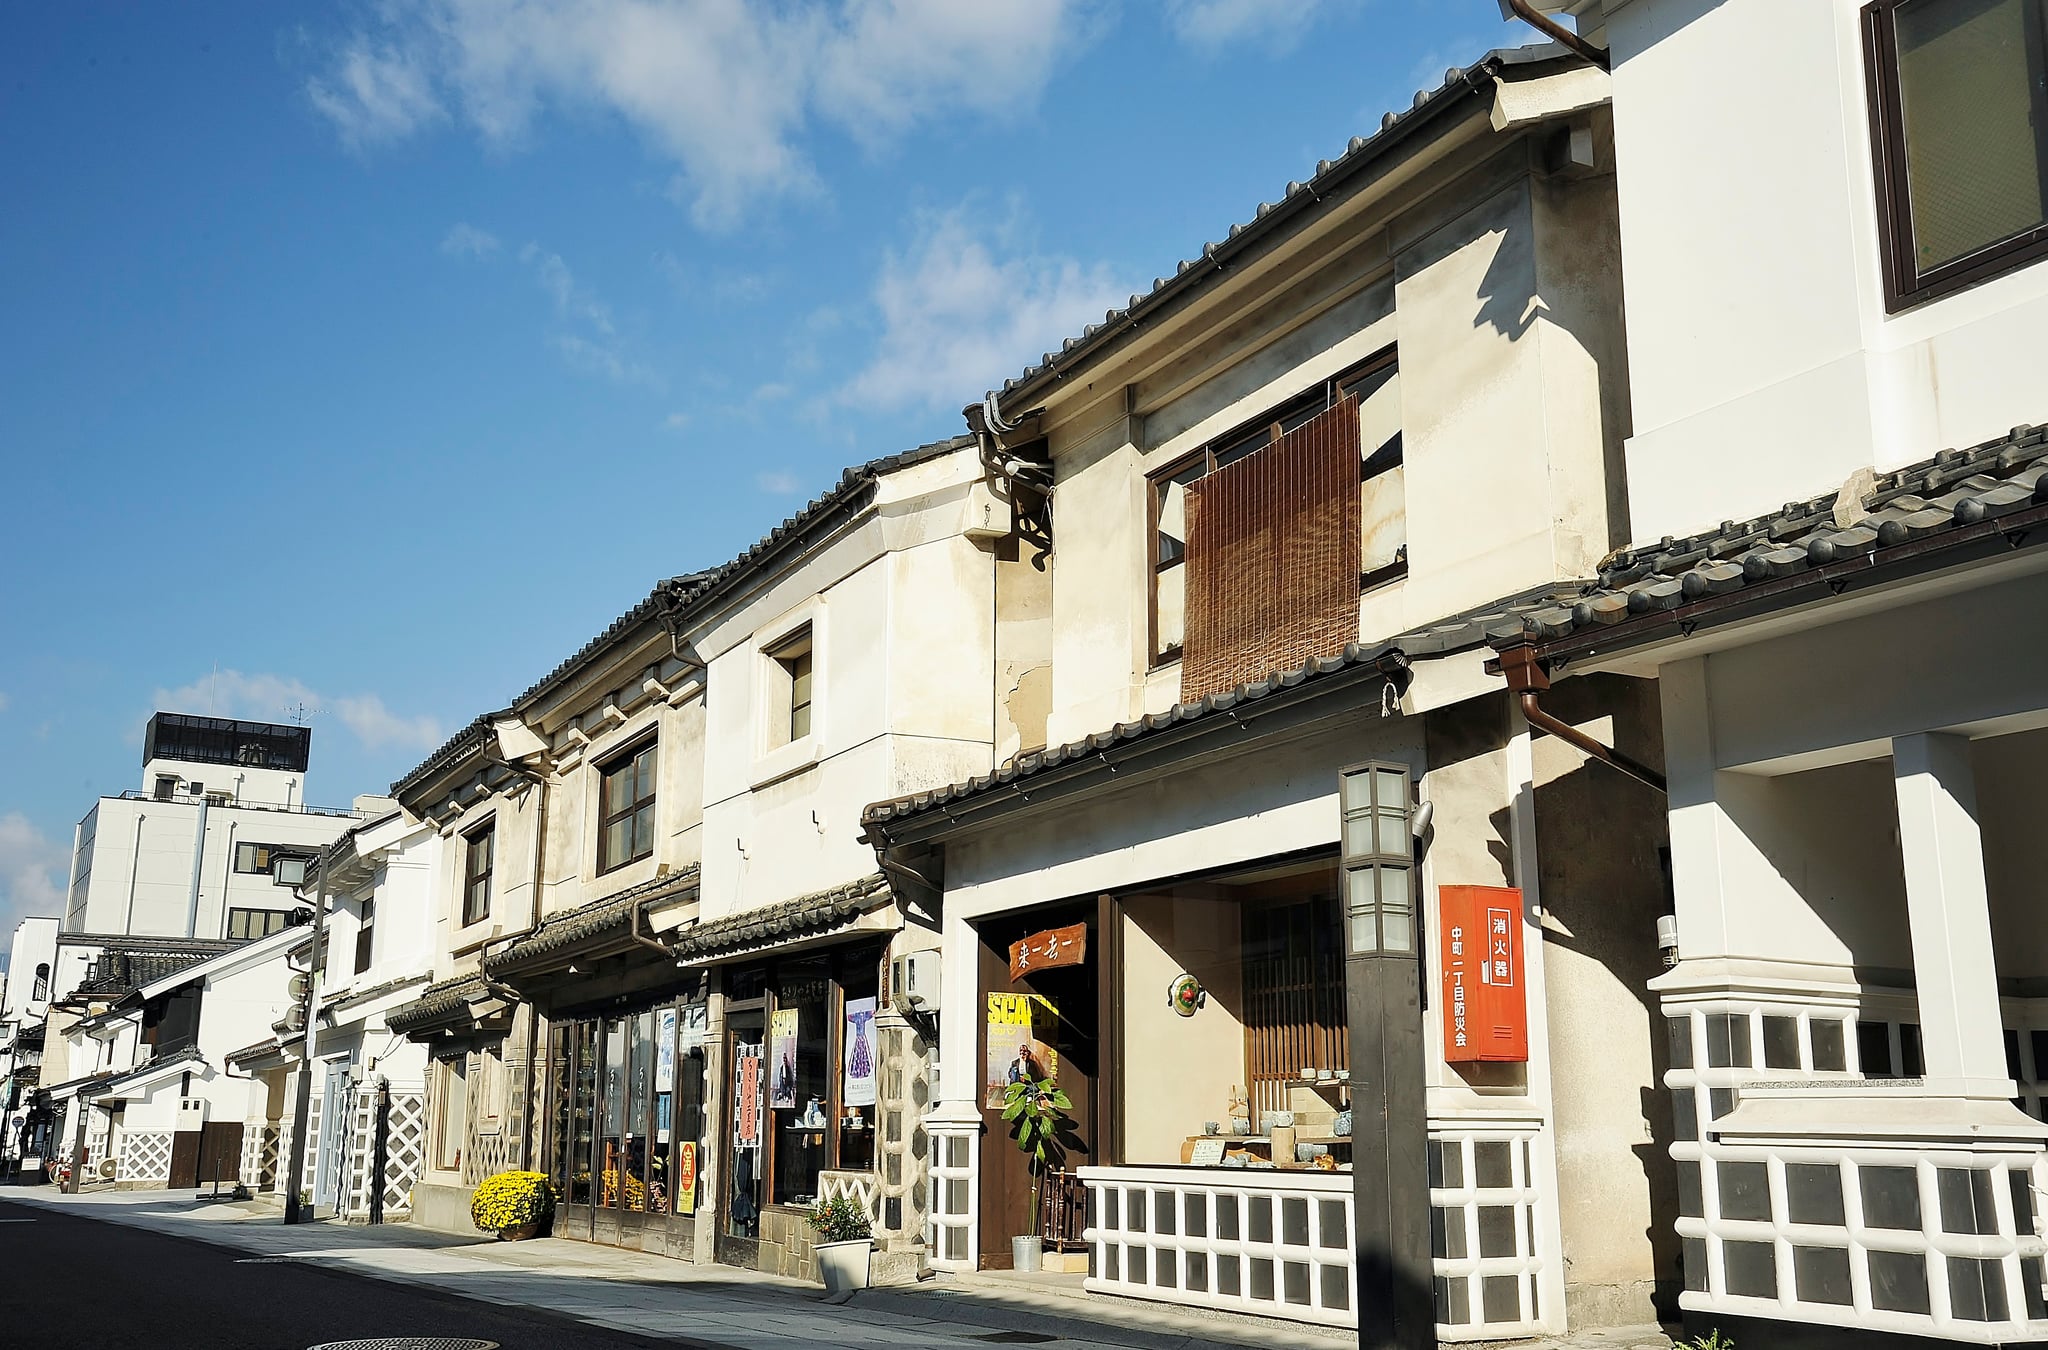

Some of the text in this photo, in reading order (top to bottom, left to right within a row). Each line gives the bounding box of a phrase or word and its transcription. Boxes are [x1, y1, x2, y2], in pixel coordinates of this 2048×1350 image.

[1451, 926, 1467, 1047] 中町一丁目防災会
[1493, 918, 1508, 978] 消火器
